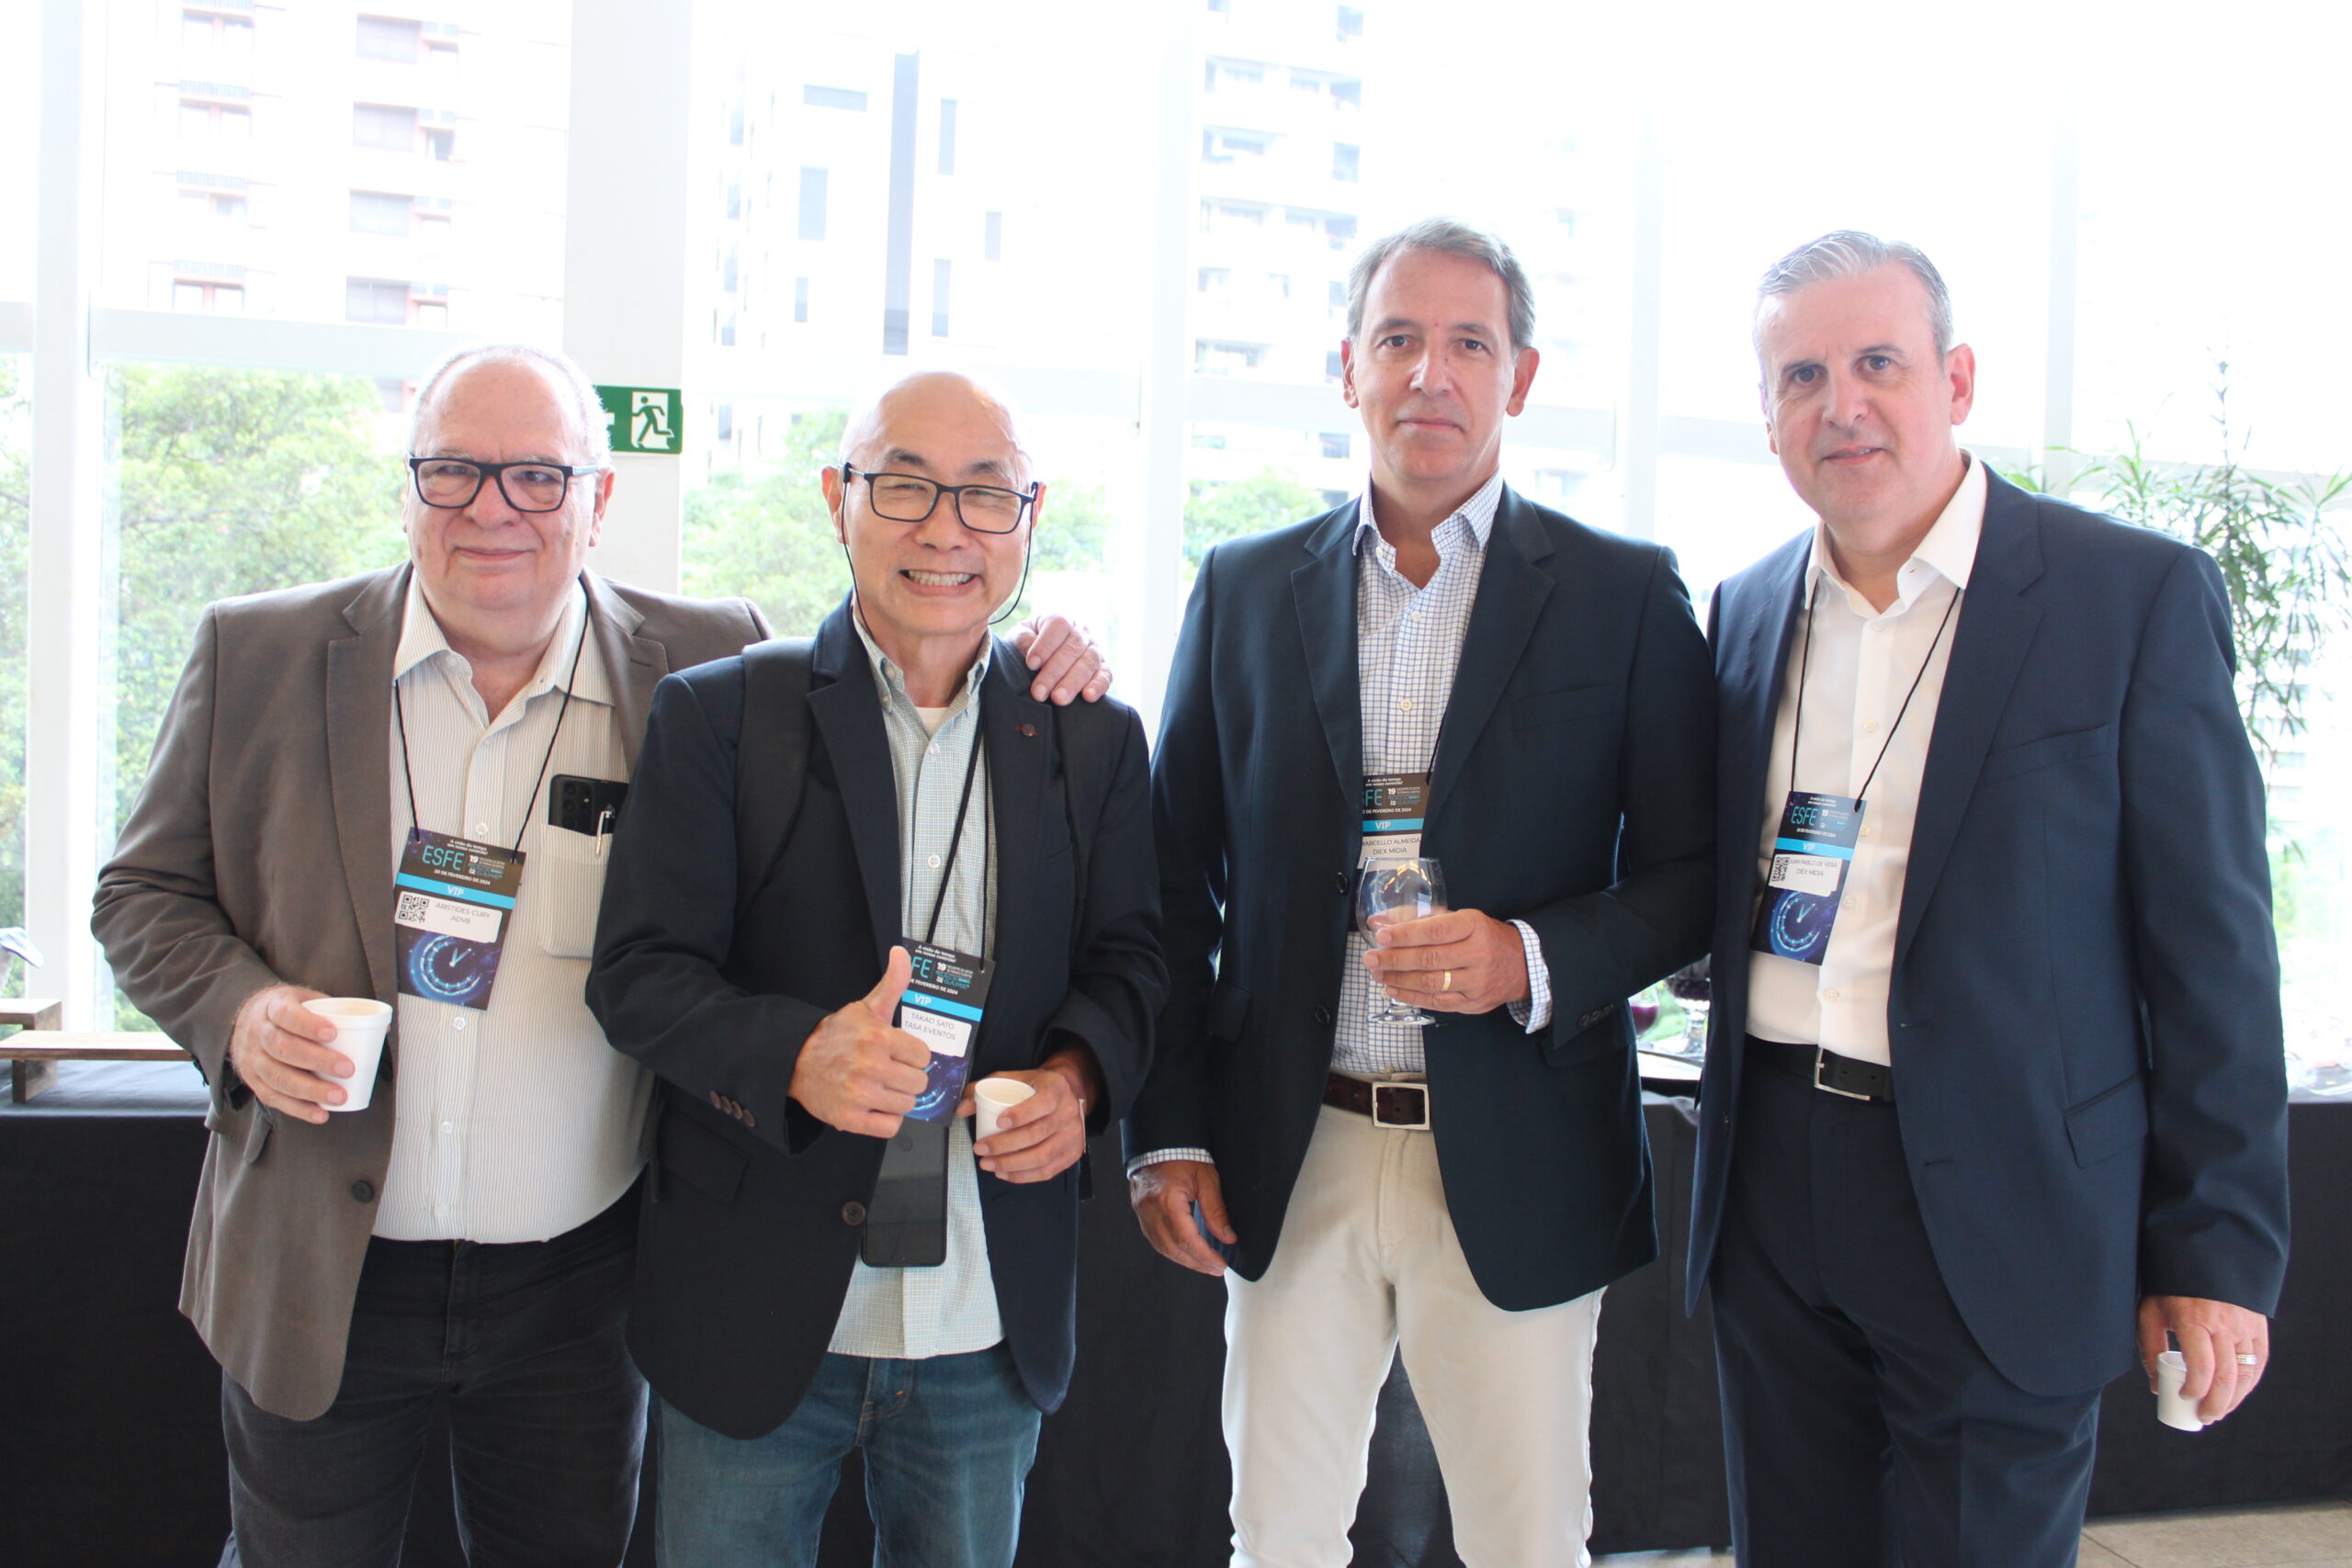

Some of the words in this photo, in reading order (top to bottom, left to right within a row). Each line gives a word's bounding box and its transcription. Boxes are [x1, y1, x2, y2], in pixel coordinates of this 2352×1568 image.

[1363, 789, 1382, 807] FE
[1791, 806, 1818, 826] ESFE
[1375, 821, 1391, 830] VIP
[1803, 841, 1816, 851] VIP
[422, 845, 465, 871] ESFE
[469, 855, 479, 863] 19
[448, 871, 472, 881] FEVEREIRO
[447, 886, 464, 896] VIP
[435, 902, 470, 915] ARISTIDES
[471, 909, 491, 919] CURY
[911, 956, 933, 978] FE
[937, 962, 947, 972] 19
[915, 979, 940, 990] FEVEREIRO
[915, 993, 932, 1005] VIP
[911, 1013, 935, 1024] TAKAO
[936, 1019, 954, 1029] SATO
[905, 1021, 922, 1031] TASA
[923, 1026, 956, 1040] EVENTOS
